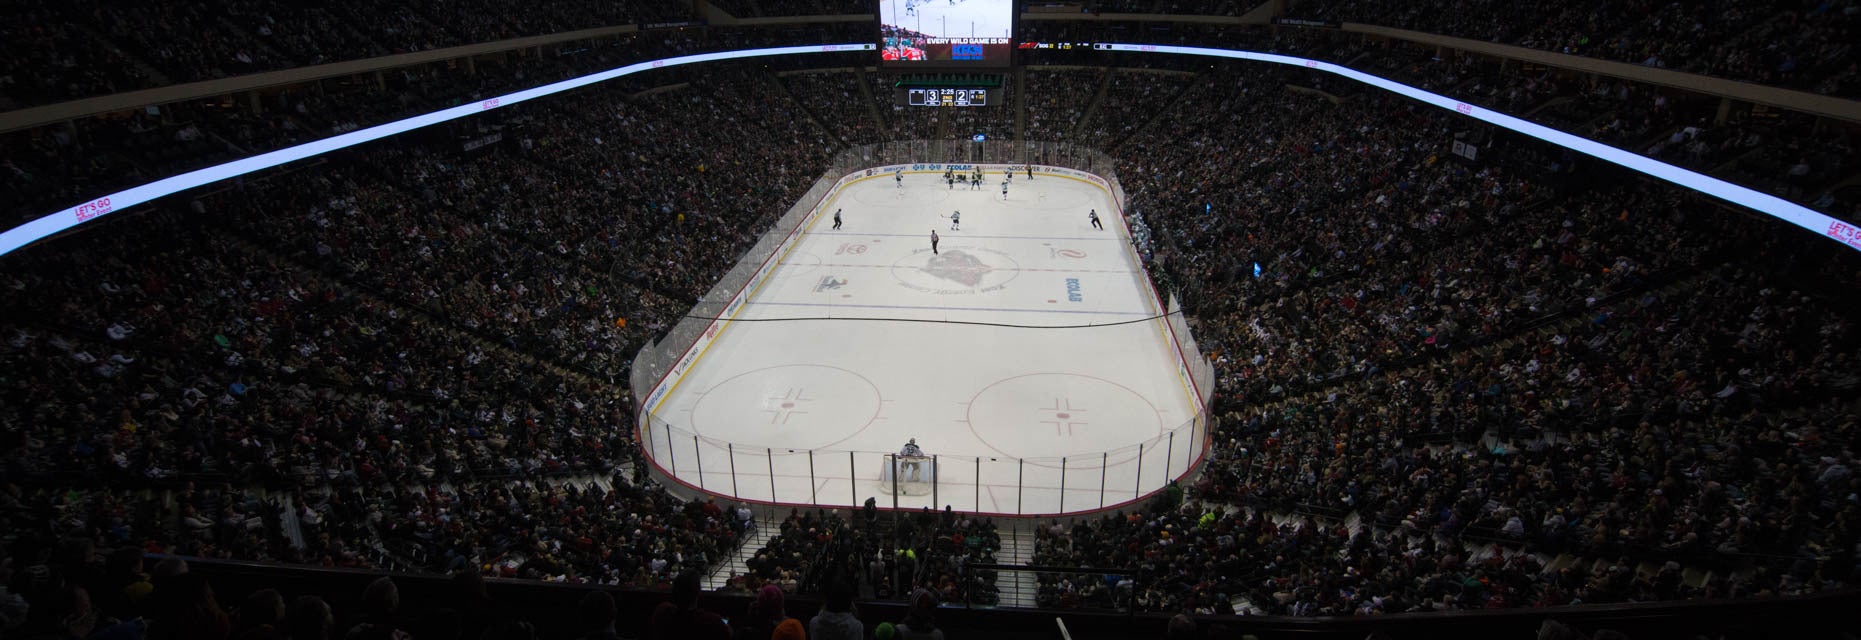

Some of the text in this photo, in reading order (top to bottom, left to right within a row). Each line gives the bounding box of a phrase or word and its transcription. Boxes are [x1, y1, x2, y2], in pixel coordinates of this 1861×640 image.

[929, 91, 936, 101] 3
[958, 91, 965, 101] 2
[75, 198, 111, 217] LET'S GO
[1829, 221, 1854, 237] LET'S
[1065, 278, 1083, 303] ECOLAB
